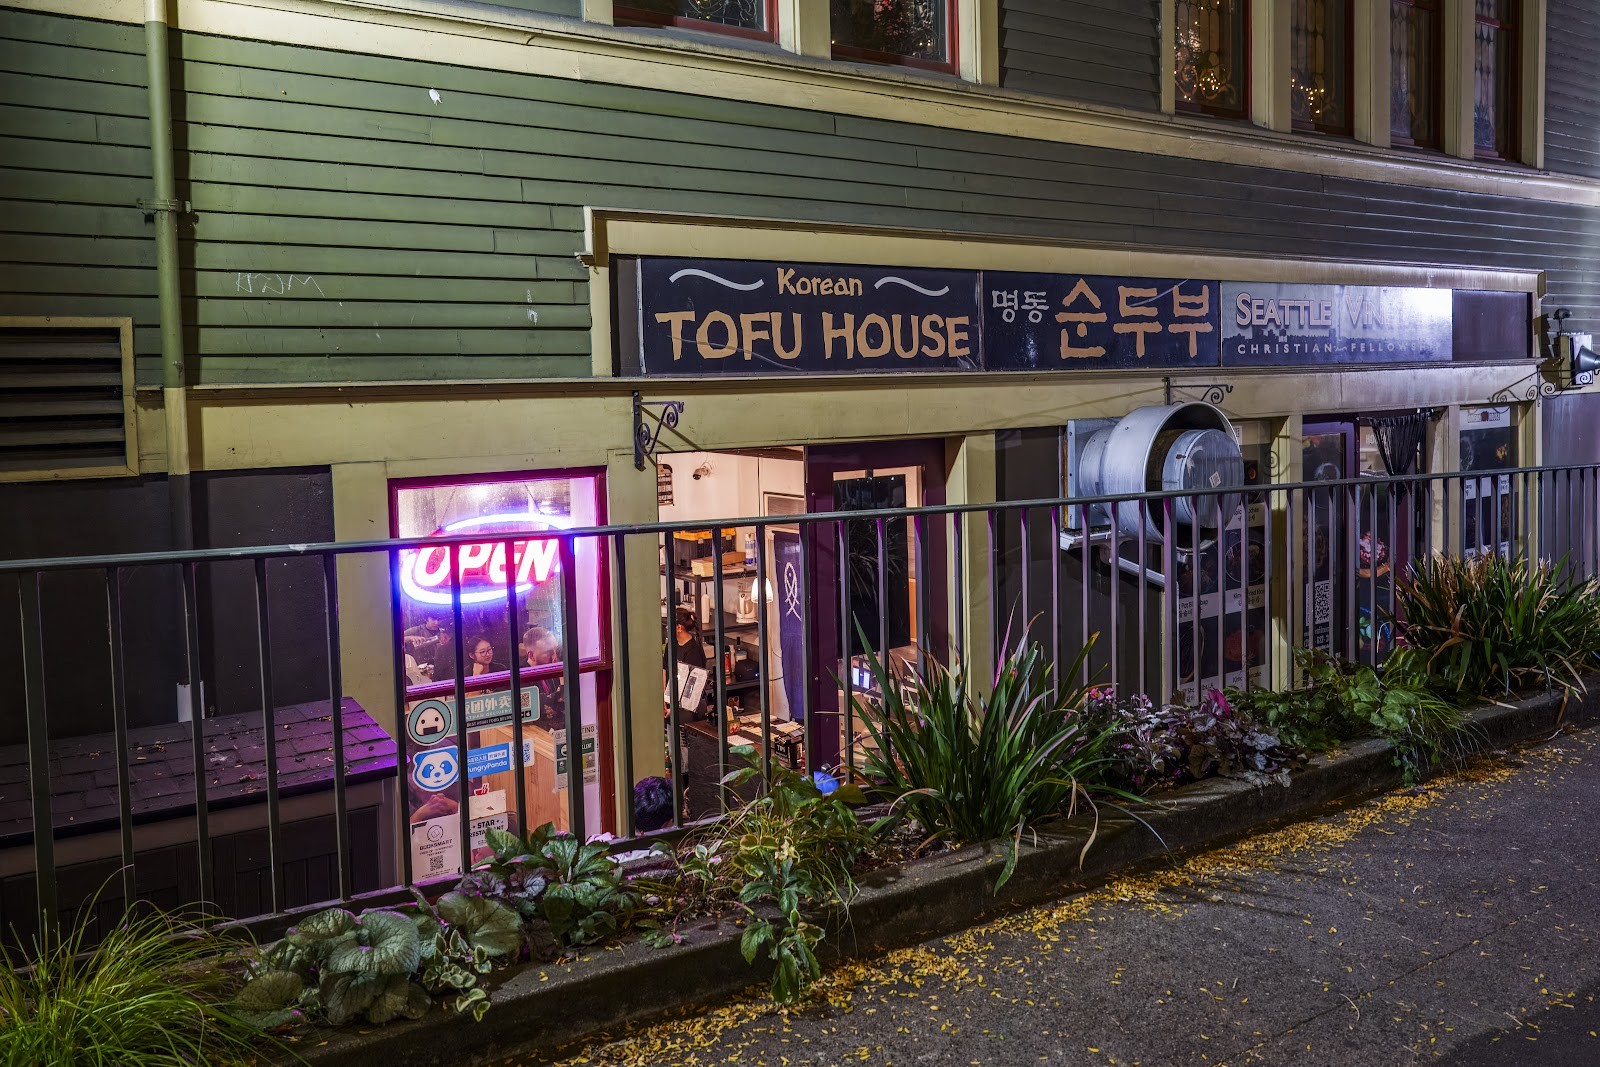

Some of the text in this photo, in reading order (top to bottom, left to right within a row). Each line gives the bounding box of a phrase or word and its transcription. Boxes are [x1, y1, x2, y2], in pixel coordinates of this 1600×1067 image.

[776, 267, 864, 297] Korean
[991, 277, 1214, 360] 명동 순두부
[1236, 292, 1333, 328] SEATTLE
[655, 310, 971, 361] TOFU HOUSE
[1237, 342, 1333, 355] CHRISTIAN
[414, 538, 561, 587] OPEN
[477, 819, 495, 829] STAR
